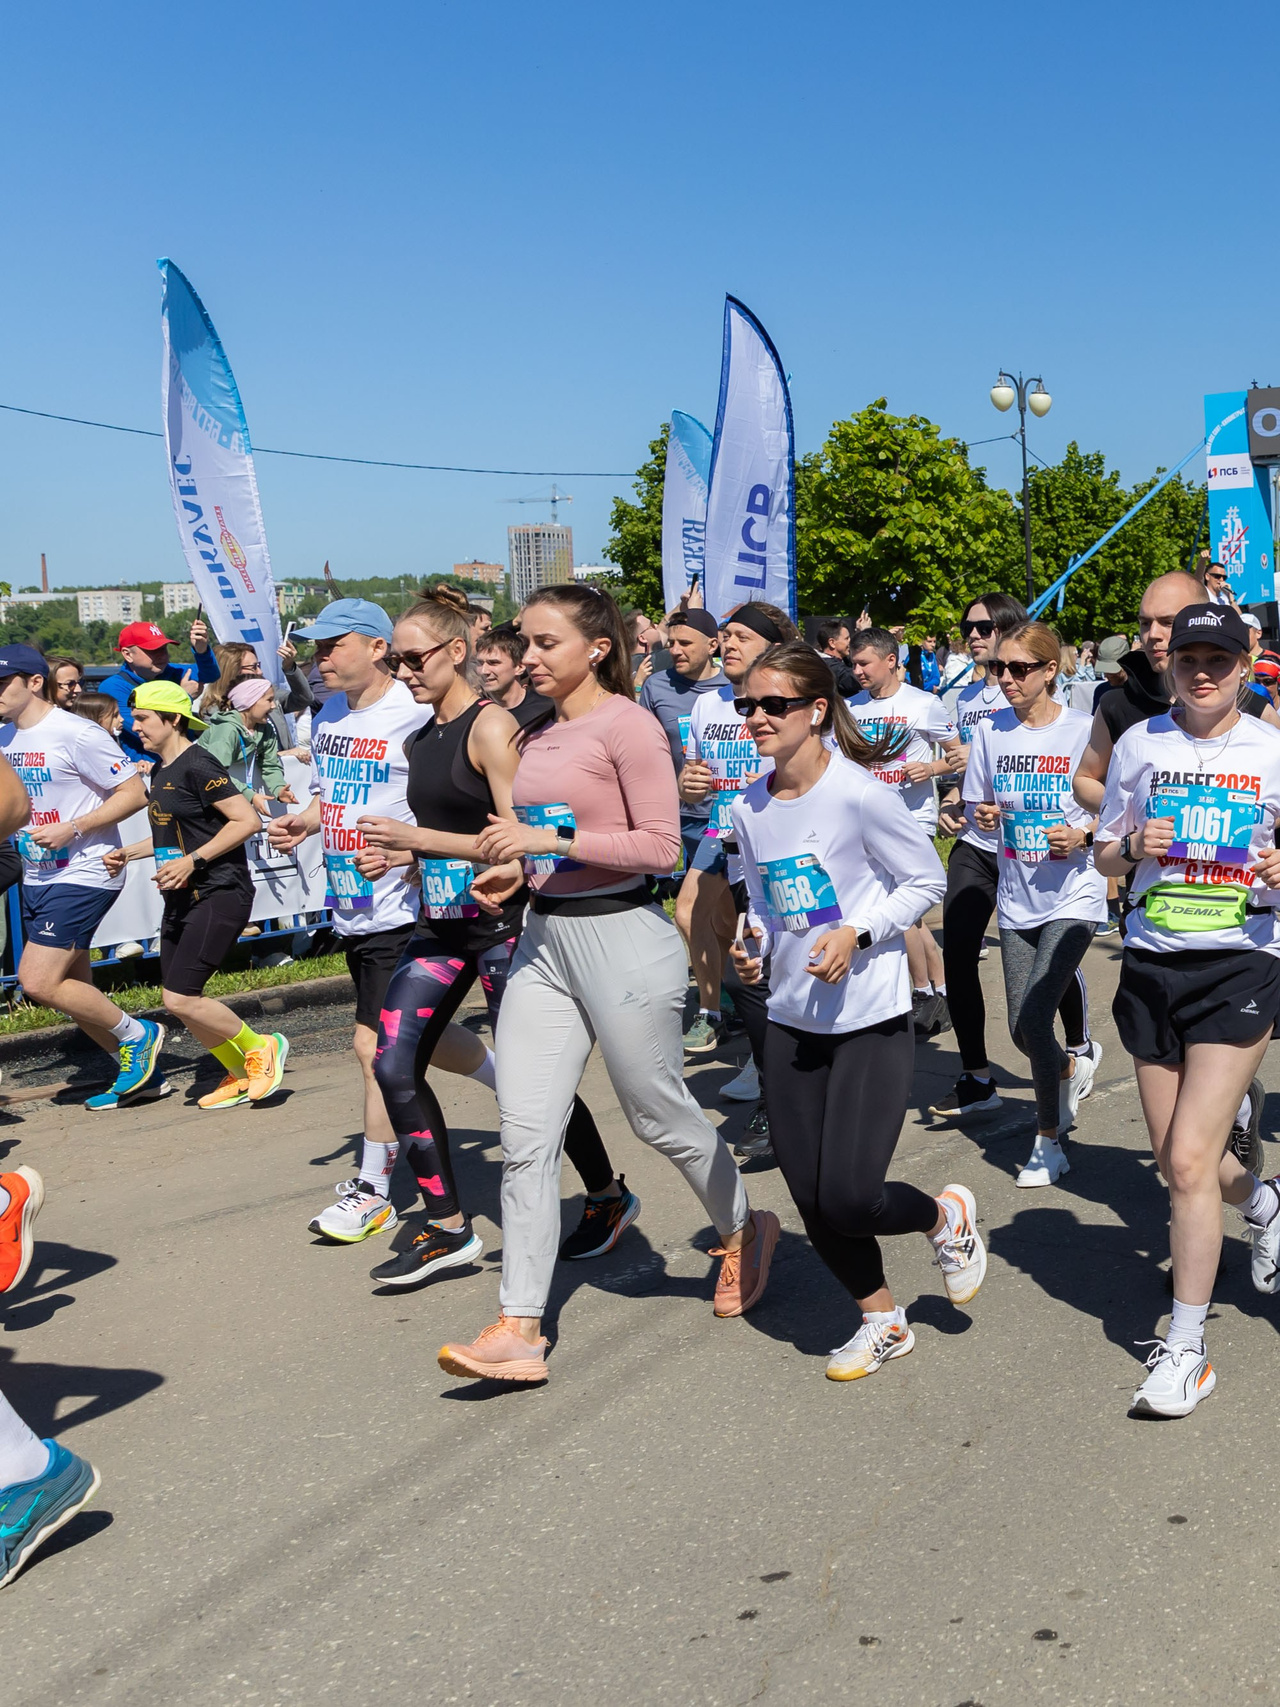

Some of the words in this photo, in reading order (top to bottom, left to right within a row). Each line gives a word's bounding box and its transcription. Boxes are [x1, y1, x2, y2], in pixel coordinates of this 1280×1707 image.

[1220, 467, 1238, 476] ПСБ
[1221, 518, 1246, 542] ЗА
[1218, 540, 1250, 564] БЕГ
[327, 757, 391, 784] ПЛАНЕТЫ
[726, 760, 762, 778] БЕГУТ
[996, 755, 1071, 774] #ЗАБЕГ2025
[332, 782, 372, 806] БЕГУТ
[993, 774, 1012, 792] 45%
[1014, 774, 1072, 792] ПЛАНЕТЫ
[1024, 792, 1061, 811] БЕГУТ
[1180, 804, 1232, 844] 1061
[324, 829, 330, 850] С
[332, 829, 371, 852] ТОБО
[1014, 825, 1049, 850] 932
[1030, 850, 1037, 862] 5
[1186, 842, 1218, 861] 10КМ
[328, 870, 358, 897] 030
[1185, 863, 1198, 885] С
[1202, 864, 1256, 888] ТОБОЙ
[426, 876, 457, 904] 934
[769, 875, 816, 914] 1058
[449, 905, 464, 919] КМ
[1171, 905, 1226, 918] DEMIX
